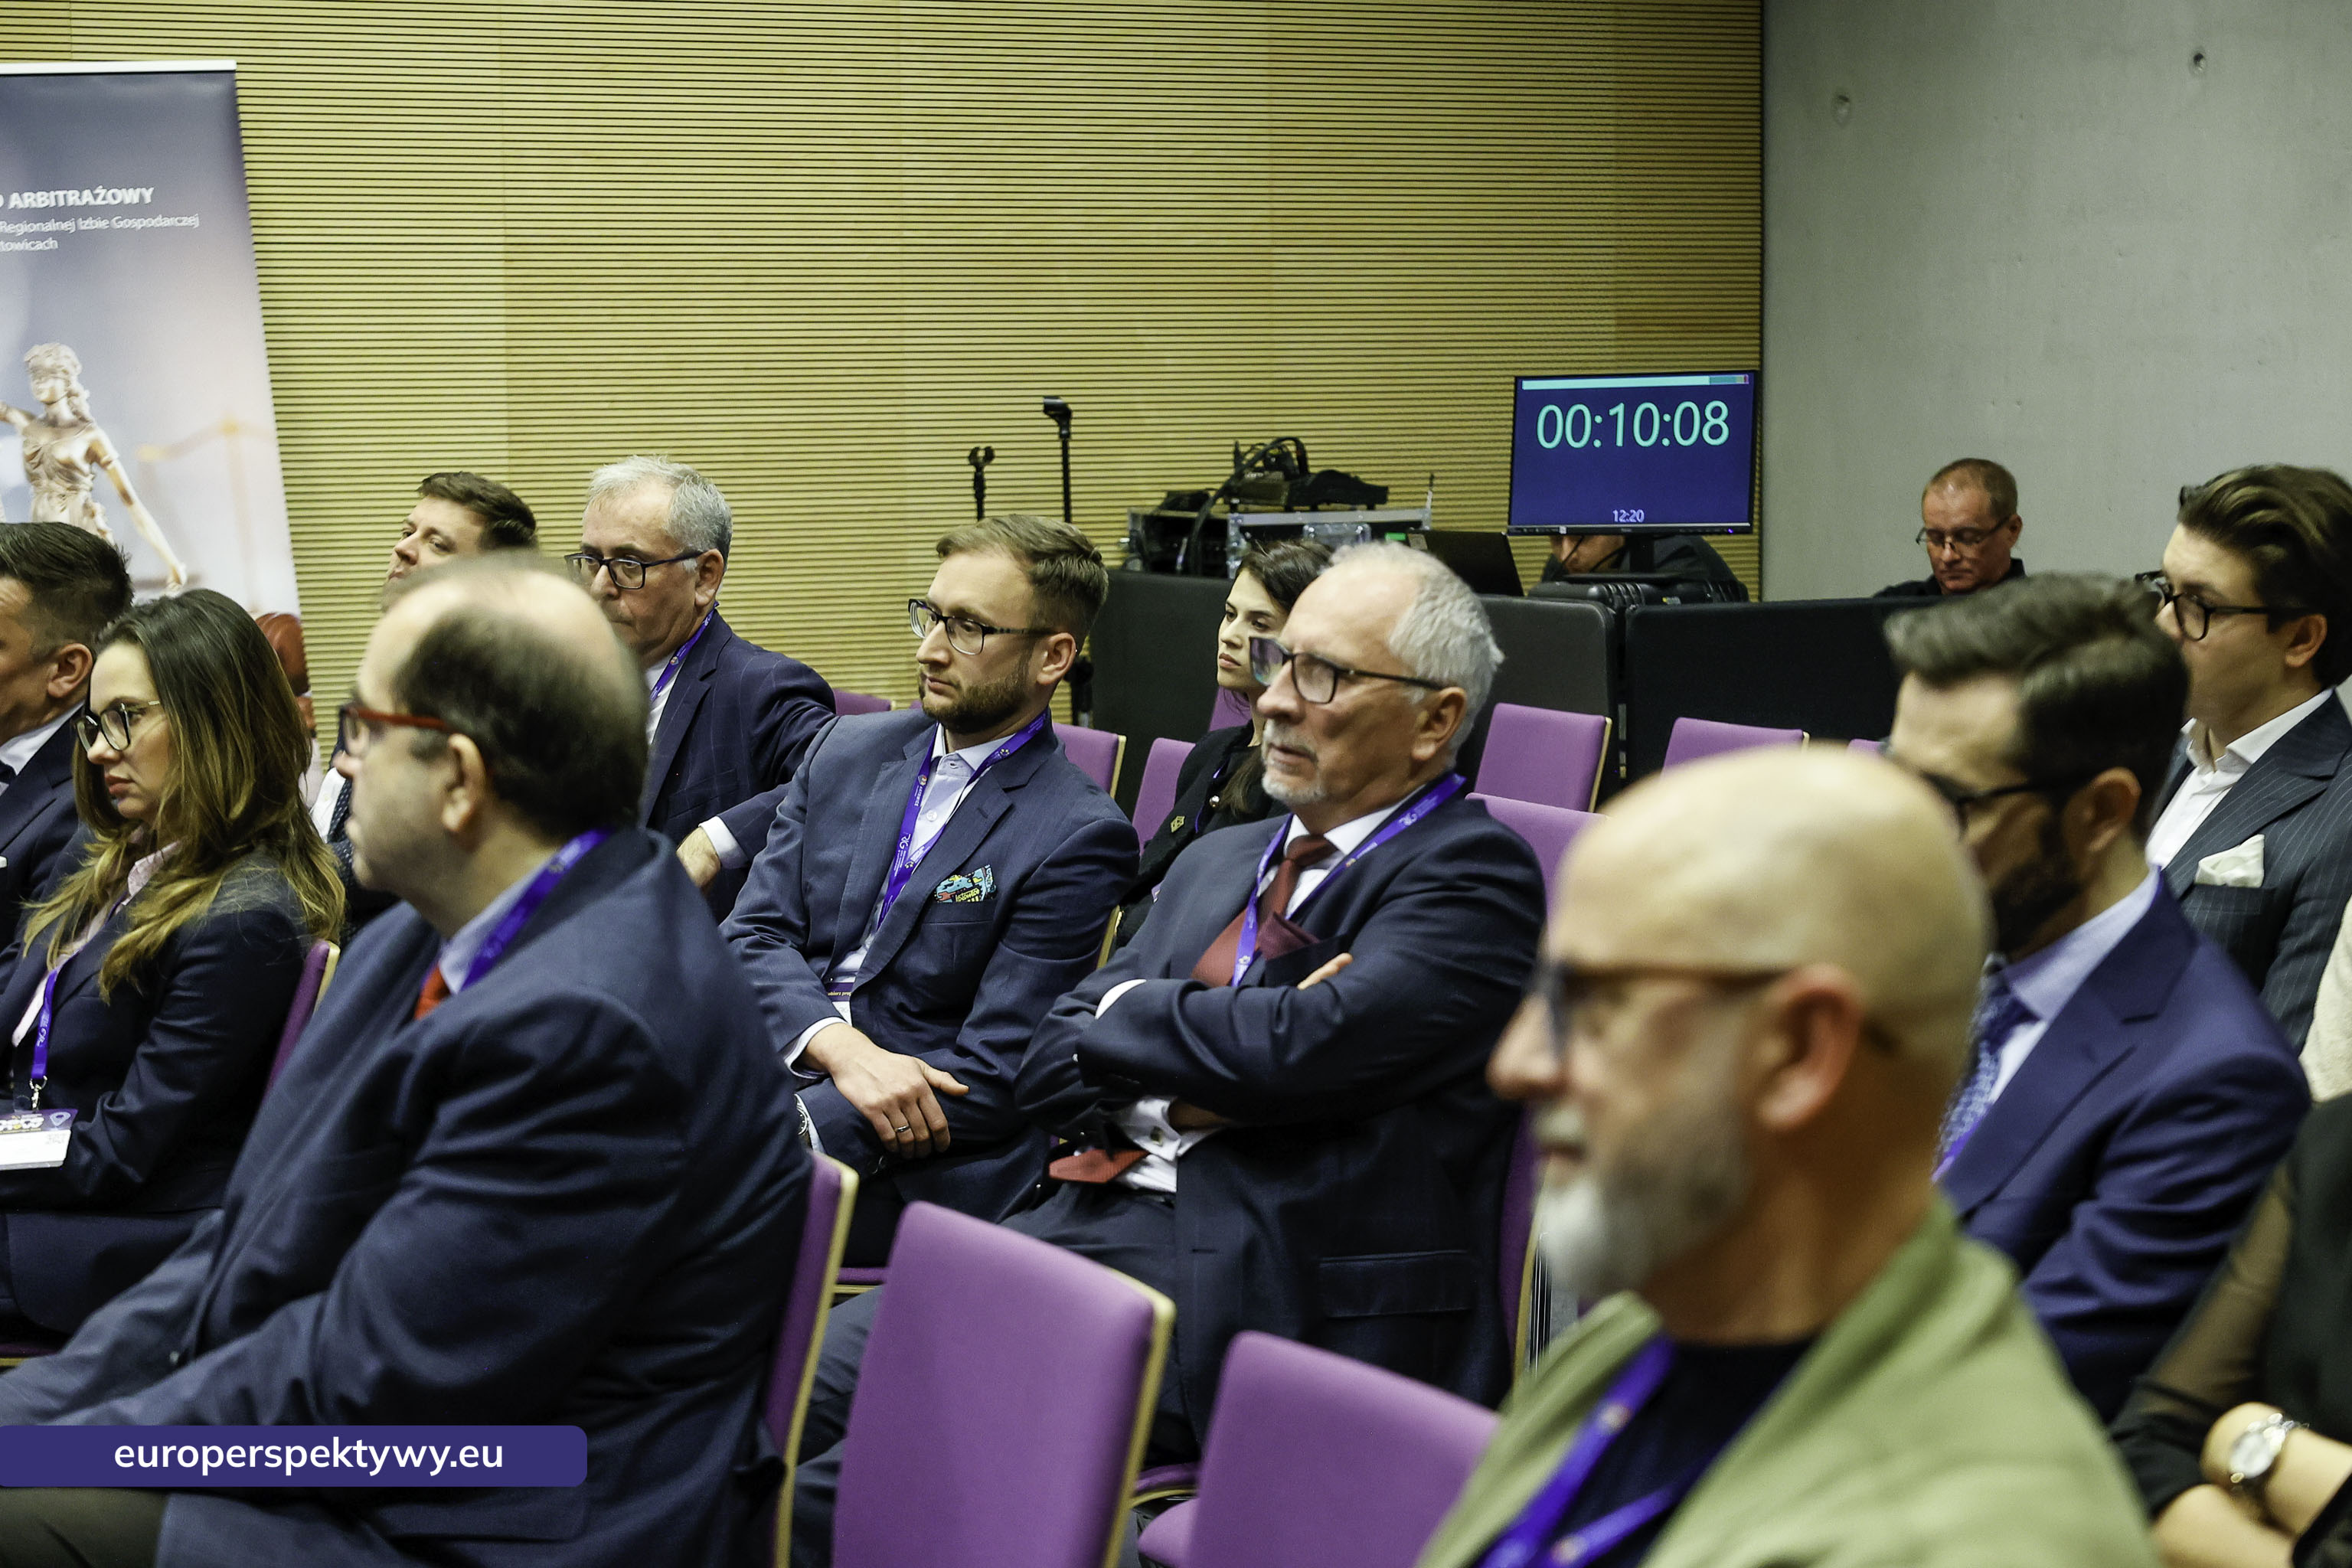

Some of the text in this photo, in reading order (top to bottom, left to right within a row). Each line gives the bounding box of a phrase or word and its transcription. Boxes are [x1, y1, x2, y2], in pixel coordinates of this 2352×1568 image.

[8, 185, 154, 209] ARBITRAŻOWY
[0, 214, 199, 237] Regionalnej Izbie Gospodarczej
[1537, 400, 1730, 449] 00:10:08
[1612, 509, 1645, 523] 12:20
